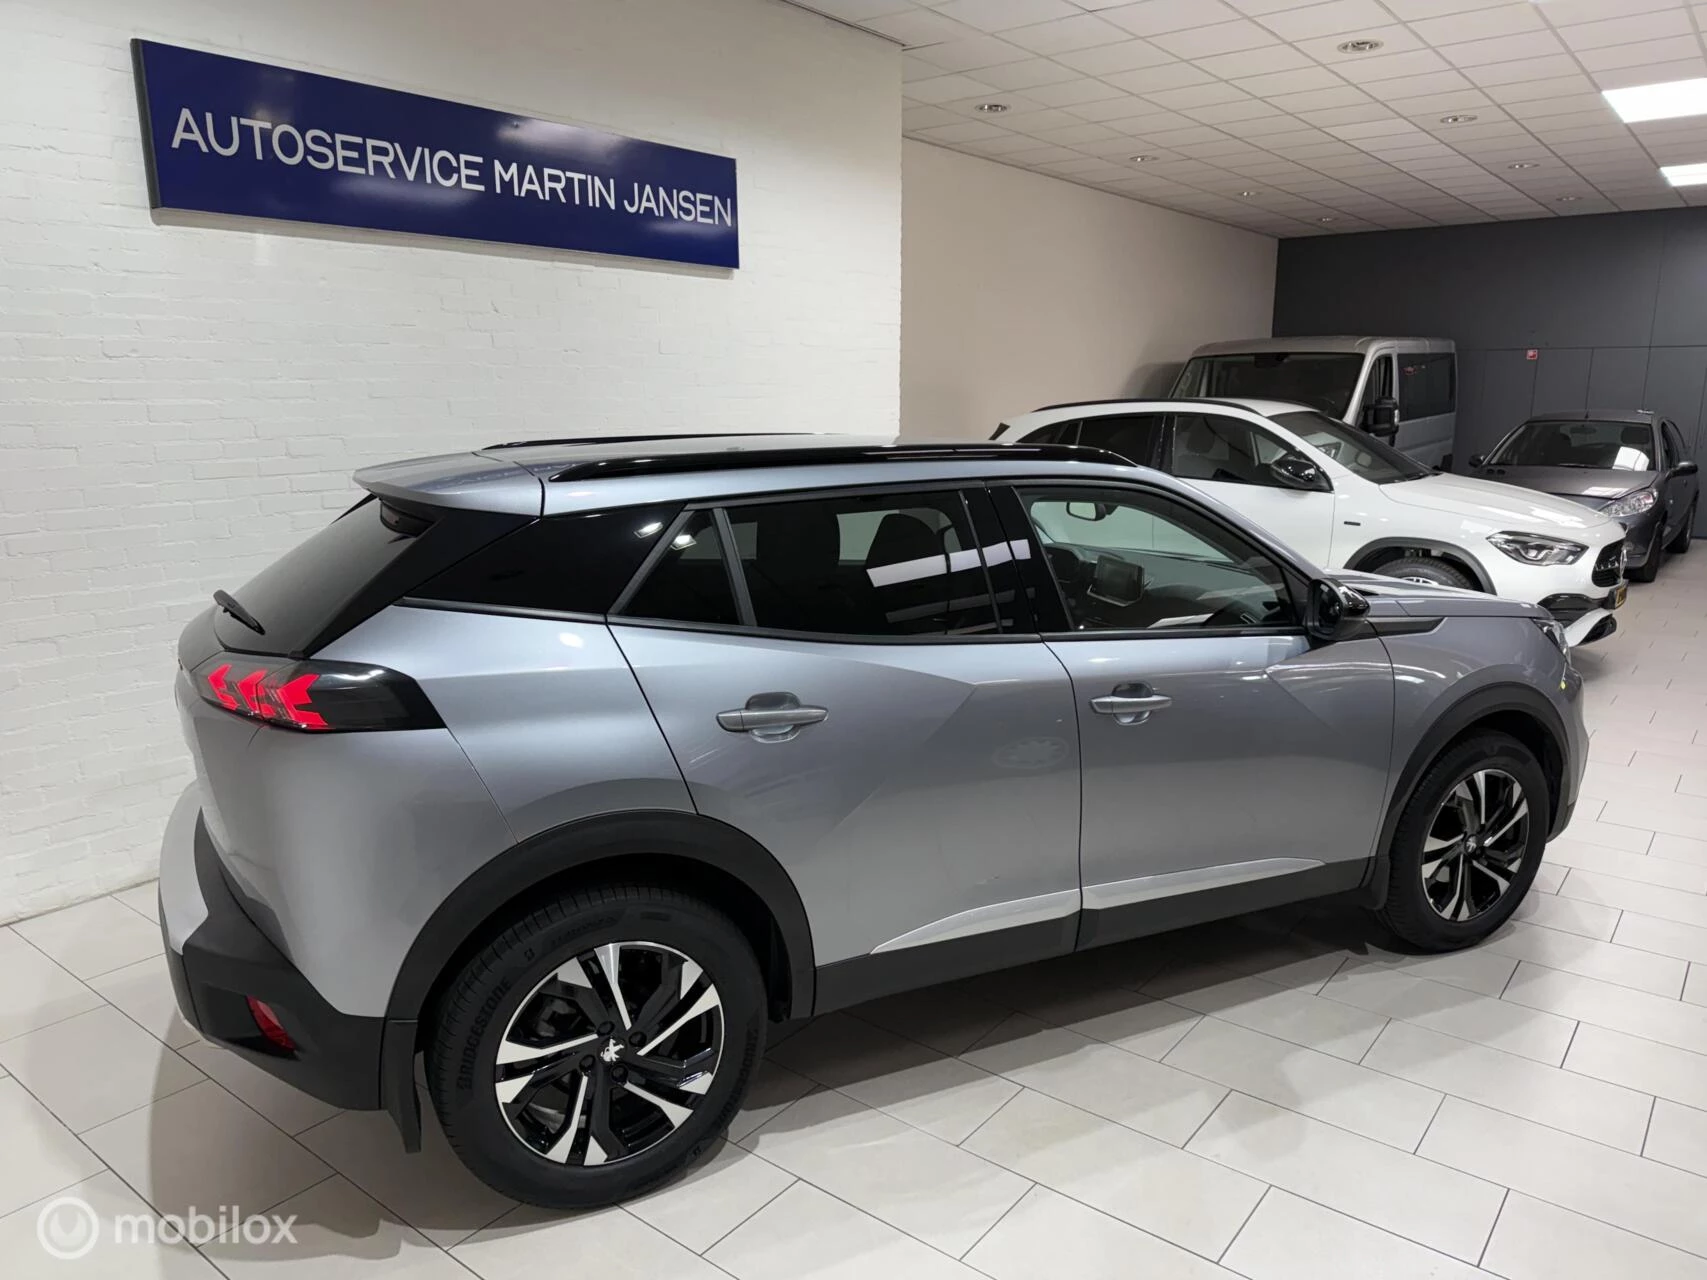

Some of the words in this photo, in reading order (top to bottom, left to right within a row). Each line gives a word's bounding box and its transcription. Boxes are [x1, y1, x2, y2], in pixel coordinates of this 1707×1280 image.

[172, 107, 485, 192] AUTOSERVICE
[494, 160, 616, 210] MARTIN
[624, 183, 732, 227] JANSEN
[455, 976, 514, 1090] BRIDGESTONE
